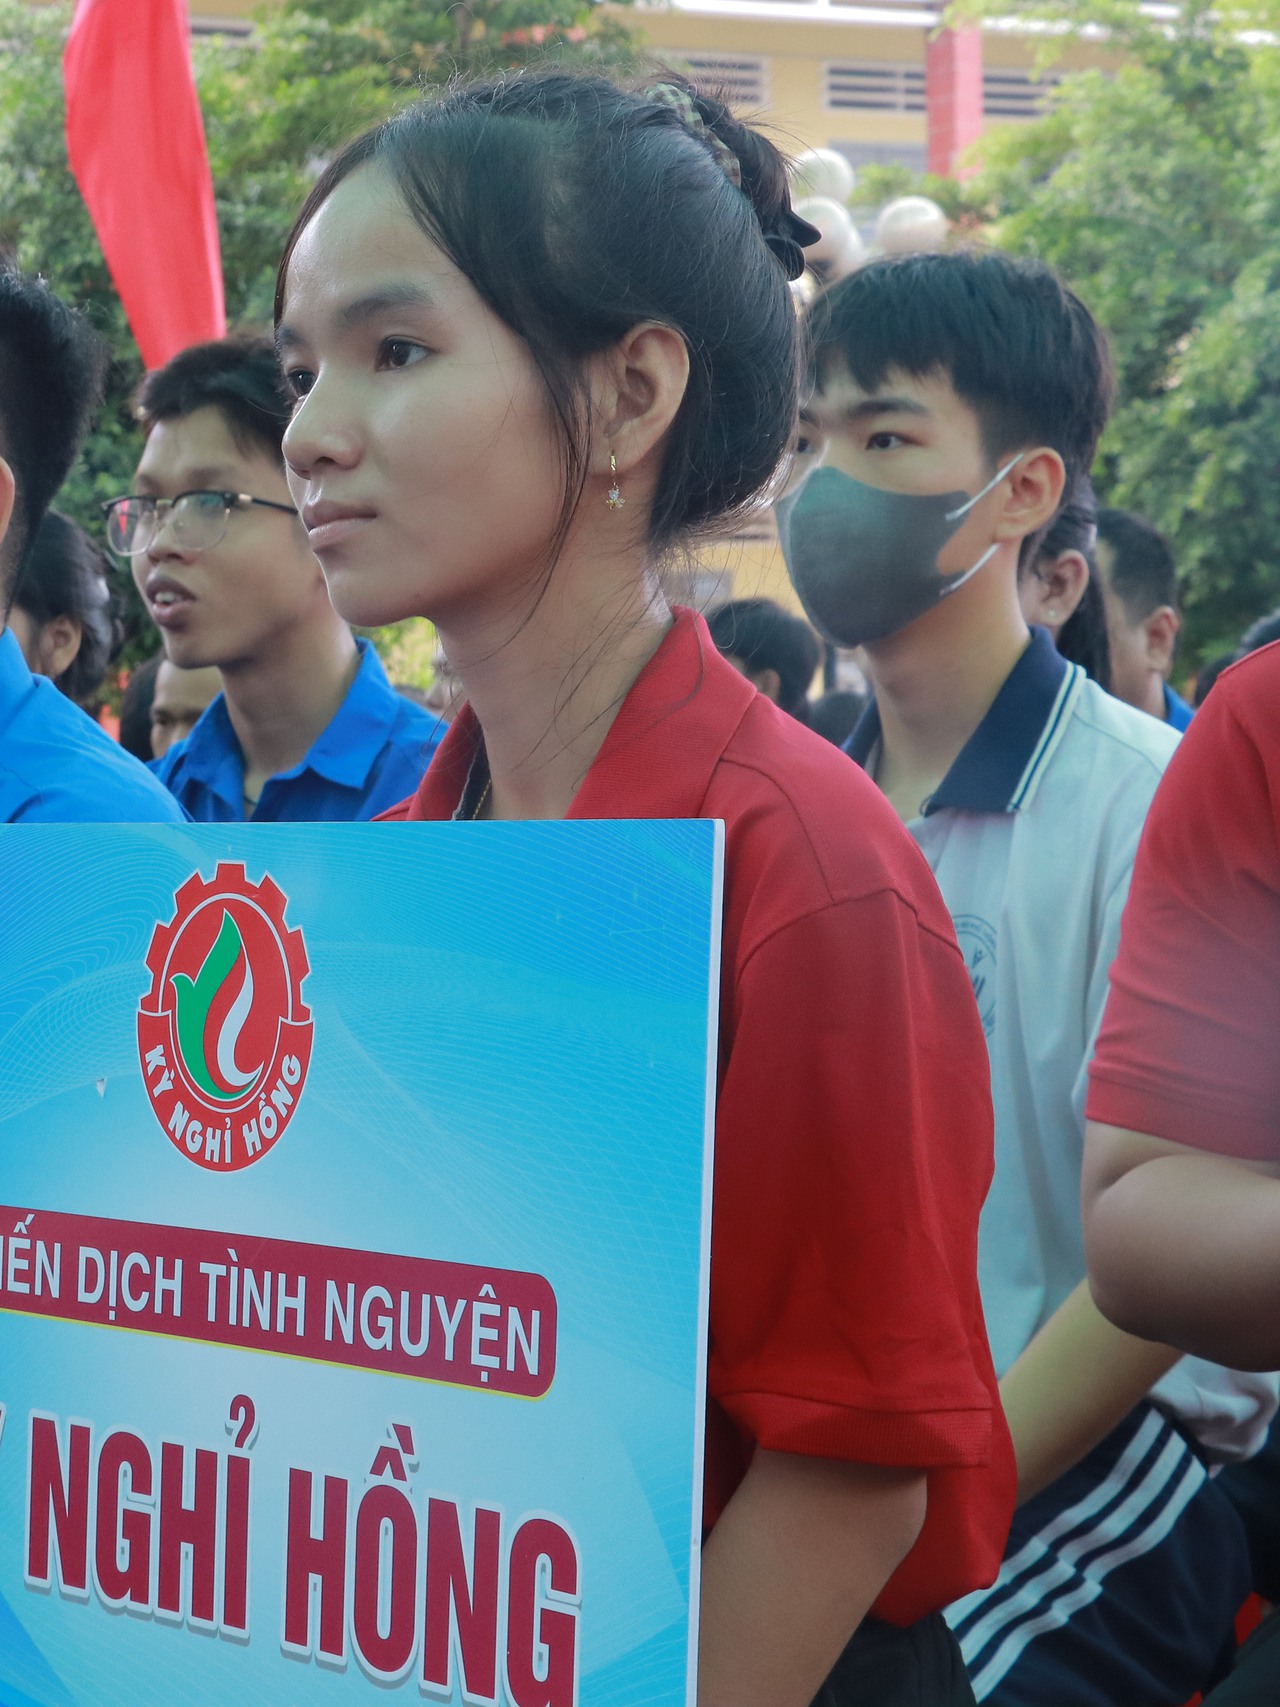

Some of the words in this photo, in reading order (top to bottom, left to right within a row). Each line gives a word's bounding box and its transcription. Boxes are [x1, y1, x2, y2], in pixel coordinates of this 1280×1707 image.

[144, 1044, 175, 1098] KỲ
[167, 1100, 233, 1164] NGHỈ
[242, 1053, 302, 1158] HỒNG
[76, 1247, 183, 1322] DỊCH
[198, 1248, 307, 1337] TÌNH
[323, 1279, 541, 1384] NGUYỆN
[24, 1394, 253, 1640] NGHỈ
[280, 1422, 581, 1707] HỒNG
